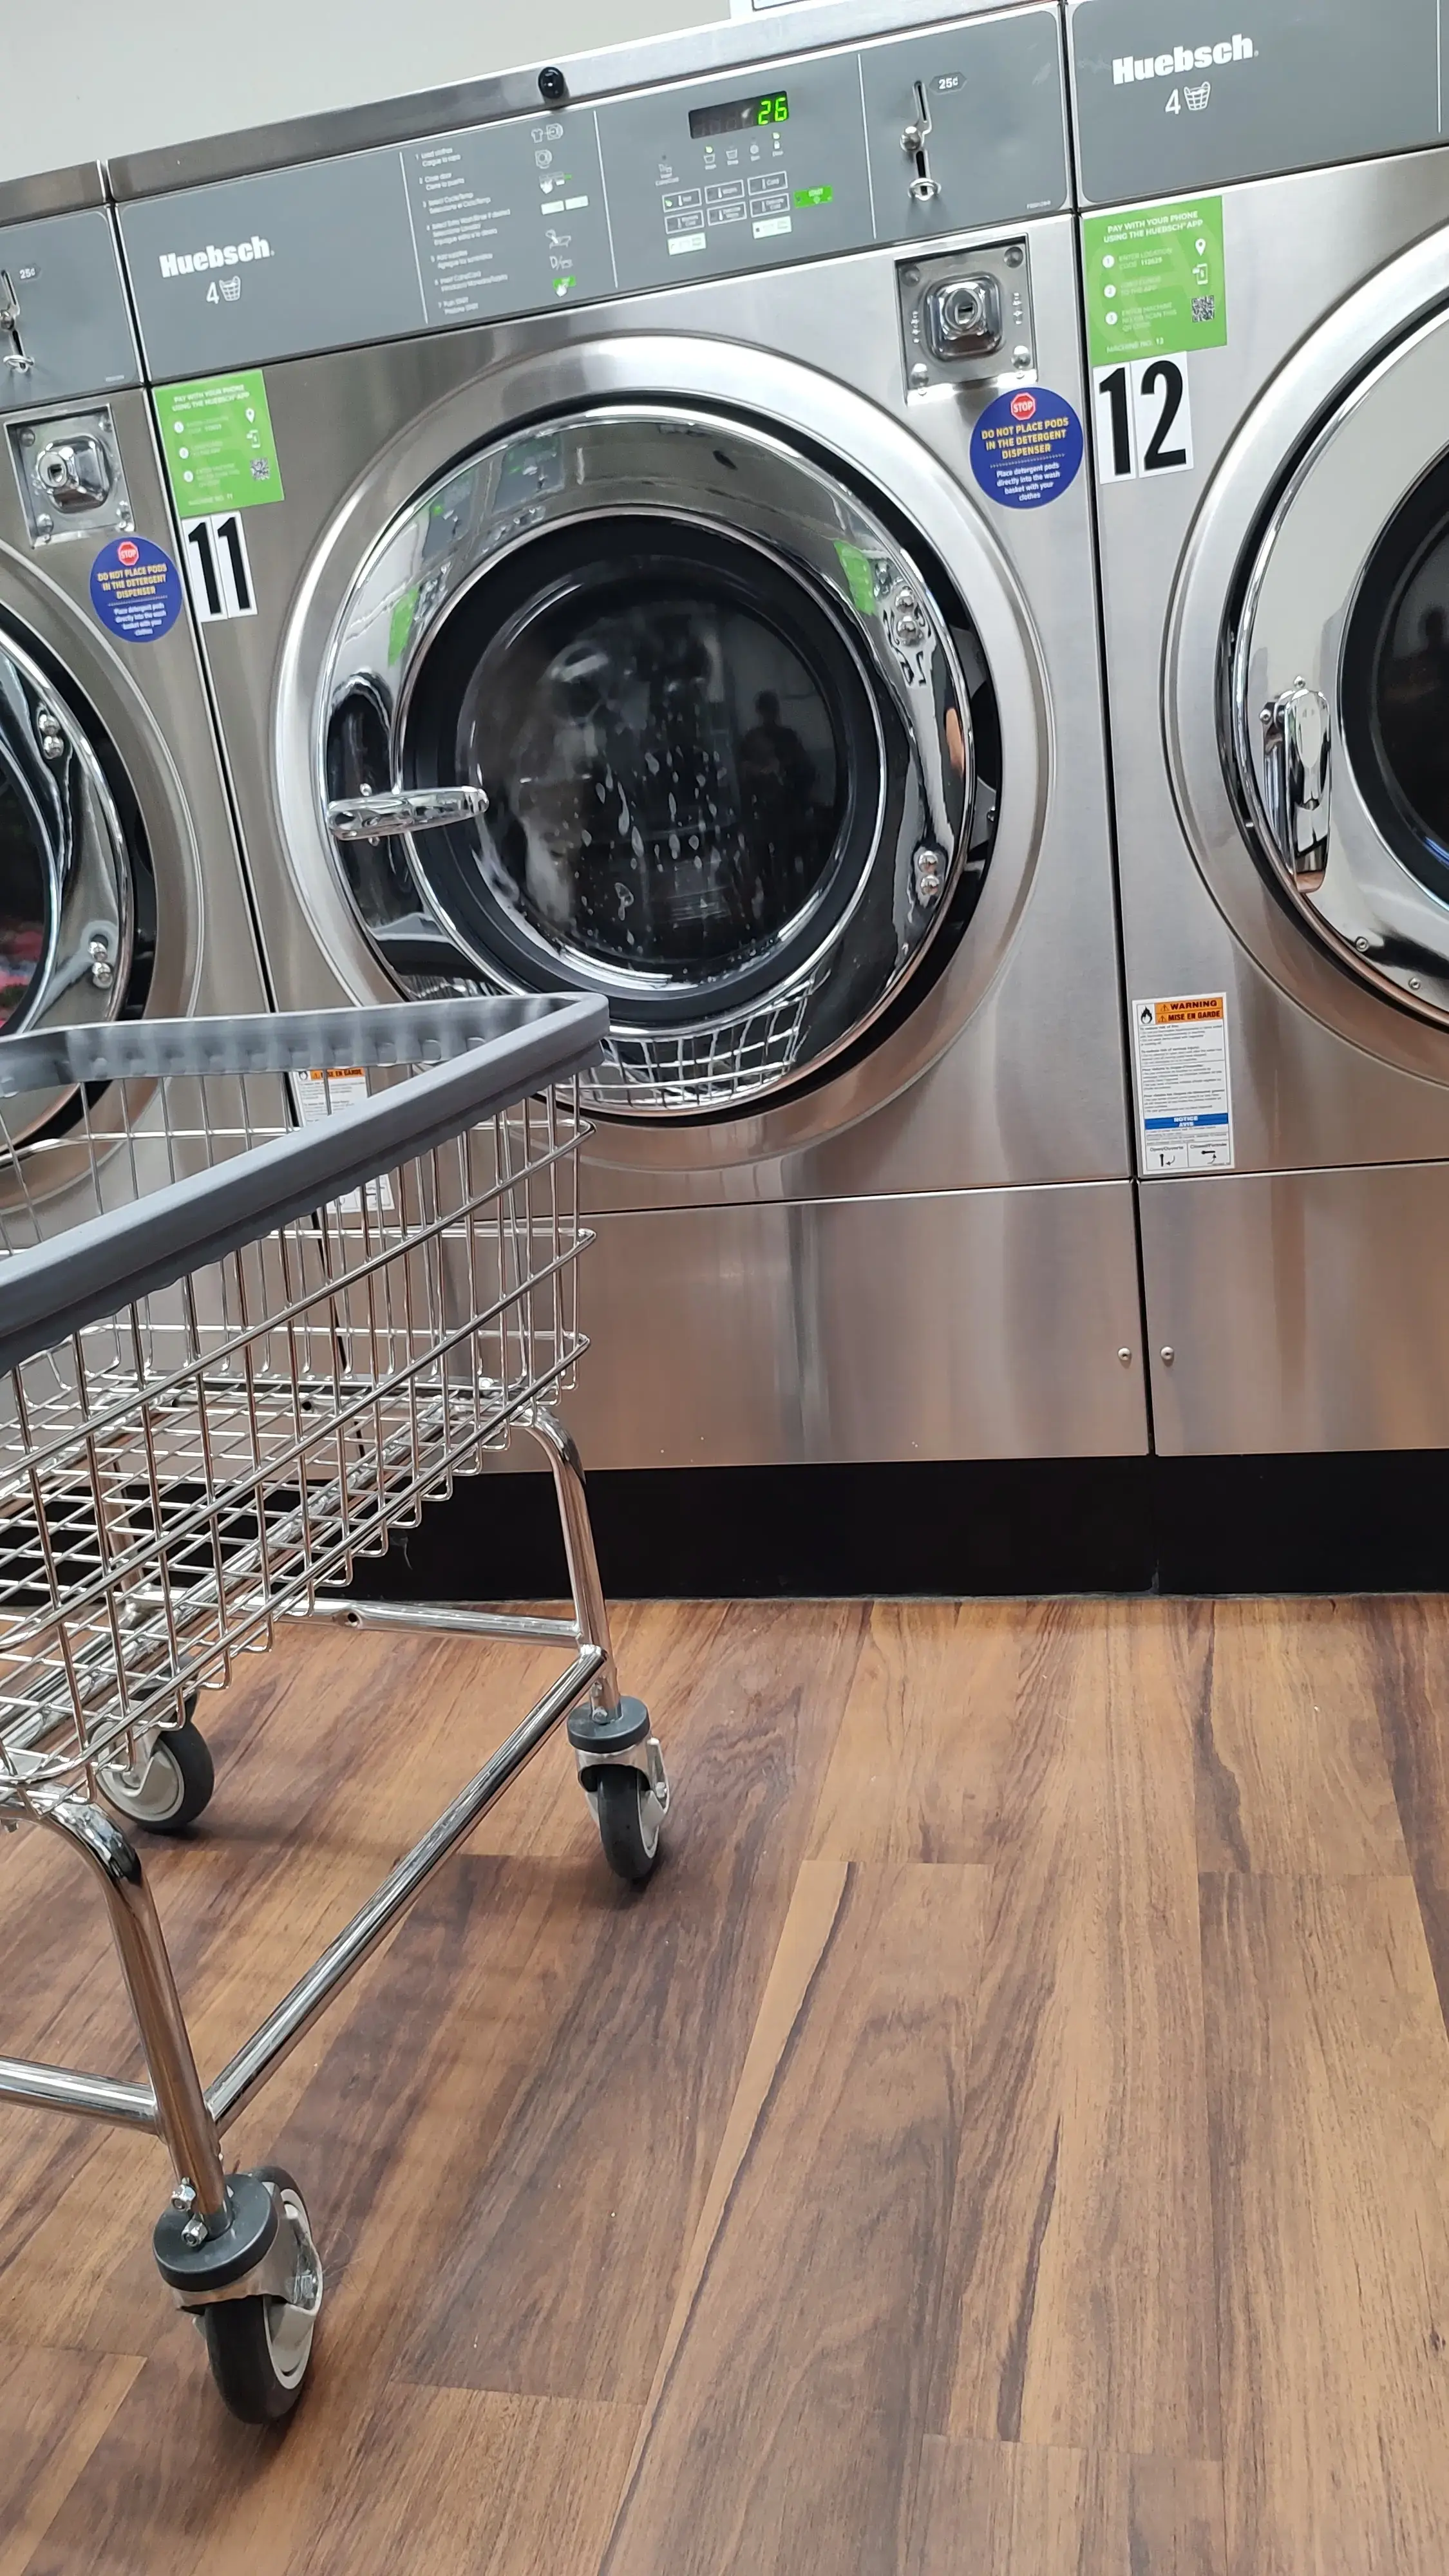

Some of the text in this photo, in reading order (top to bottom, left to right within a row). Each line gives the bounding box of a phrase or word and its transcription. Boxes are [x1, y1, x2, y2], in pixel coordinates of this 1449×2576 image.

[1113, 33, 1253, 84] Huebsch
[1165, 89, 1180, 114] 4
[757, 97, 788, 126] 26
[1104, 232, 1128, 243] USING
[1130, 229, 1144, 238] THE
[1187, 219, 1203, 229] APP
[1108, 211, 1198, 234] PAY WITH YOUR PHONE
[160, 236, 270, 278] Huebsch
[206, 281, 220, 304] 4
[1014, 401, 1033, 413] STOP
[1099, 361, 1186, 475] 12
[981, 417, 1069, 439] DO NOT PLACE PODS
[986, 429, 1067, 451] IN THE DETERGENT
[1002, 443, 1051, 460] DISPENSER
[997, 462, 1060, 478] Place detergent pods
[997, 477, 1019, 487] directly
[1005, 482, 1054, 495] basket with your
[1019, 492, 1041, 501] clothes
[120, 549, 137, 559] STOP
[97, 563, 167, 582] DO NOT PLACE PODS
[188, 516, 251, 616] 11
[102, 574, 166, 591] IN THE DETERGENT
[116, 586, 156, 600] DISPENSER
[1170, 999, 1217, 1010] WARNING
[1198, 1010, 1220, 1019] GARDE
